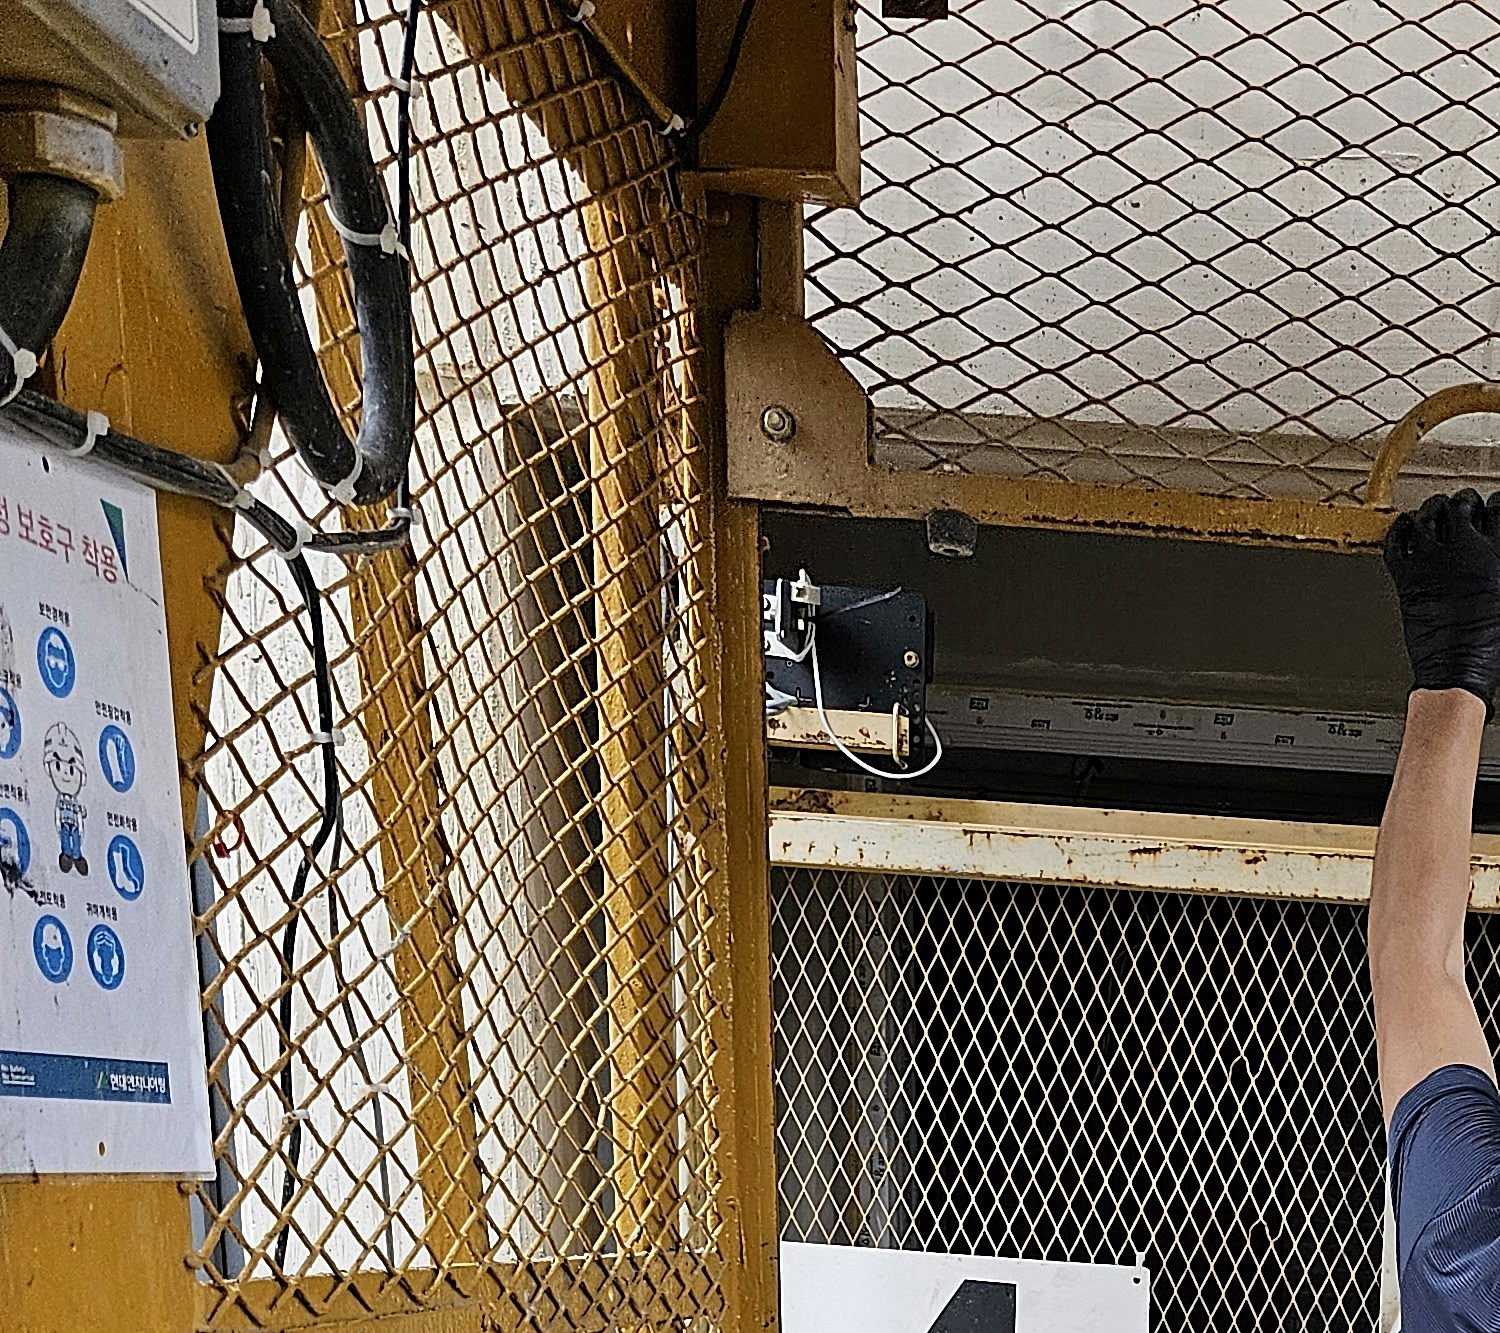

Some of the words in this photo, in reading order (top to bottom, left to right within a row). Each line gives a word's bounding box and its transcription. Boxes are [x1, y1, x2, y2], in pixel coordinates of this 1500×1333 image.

[17, 503, 75, 563] 보호구
[82, 535, 118, 584] 착용
[110, 1073, 166, 1093] 현대엔지니어링
